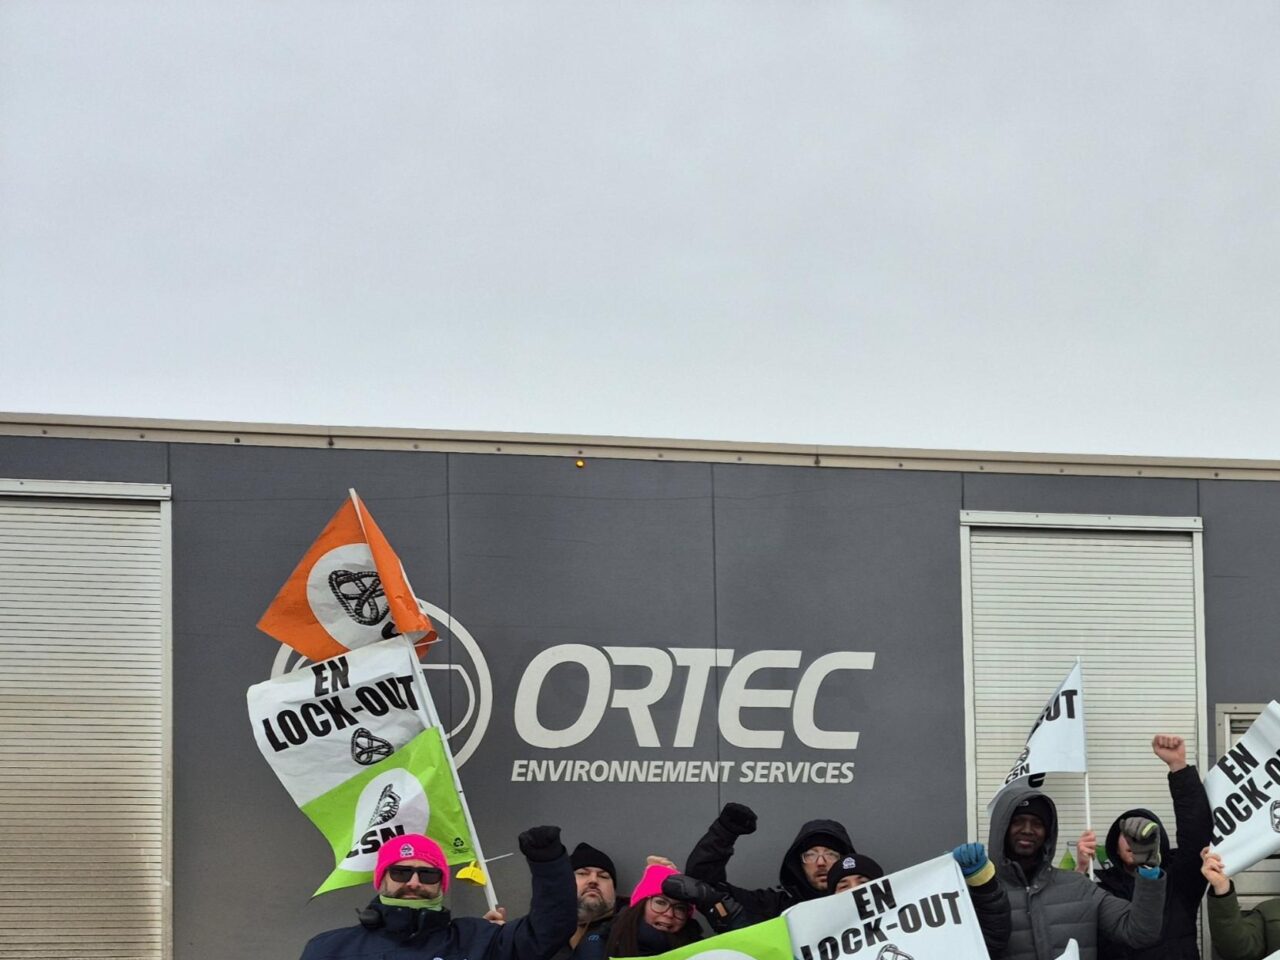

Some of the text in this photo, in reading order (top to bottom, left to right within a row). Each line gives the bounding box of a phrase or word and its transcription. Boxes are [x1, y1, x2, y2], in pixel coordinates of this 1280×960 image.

[311, 656, 350, 697] EN
[513, 643, 876, 750] ORTEC
[262, 675, 420, 752] LOCK-OUT
[510, 759, 855, 784] ENVIRONNEMENT SERVICES
[1217, 742, 1260, 785] EN
[852, 878, 897, 921] EN
